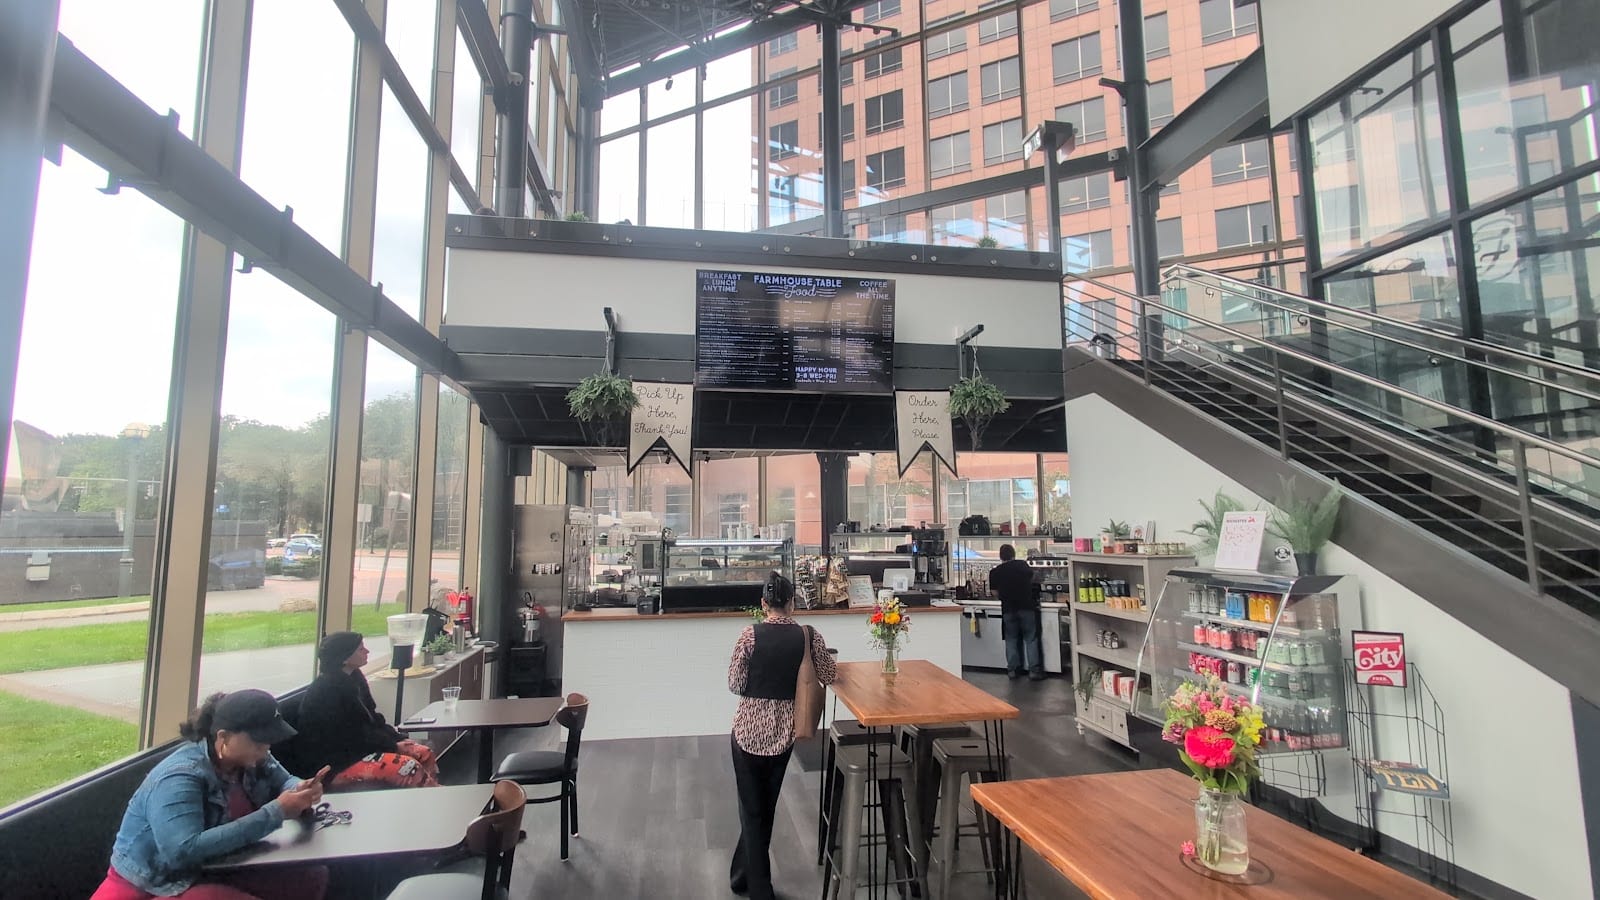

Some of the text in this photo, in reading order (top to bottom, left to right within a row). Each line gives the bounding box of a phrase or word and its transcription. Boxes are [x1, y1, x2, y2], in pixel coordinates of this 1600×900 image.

[699, 272, 742, 281] BREAKFAST
[712, 279, 737, 287] LUNCH
[754, 274, 842, 288] FARMHOUSE TABLE
[859, 280, 888, 288] COFFEE
[867, 286, 879, 294] ALL
[784, 284, 817, 299] Food
[856, 292, 889, 301] THE TIME
[636, 386, 685, 405] Pick Up
[908, 394, 938, 407] Order
[647, 405, 677, 419] Here,
[634, 422, 689, 439] Thank You!
[1354, 644, 1404, 670] City
